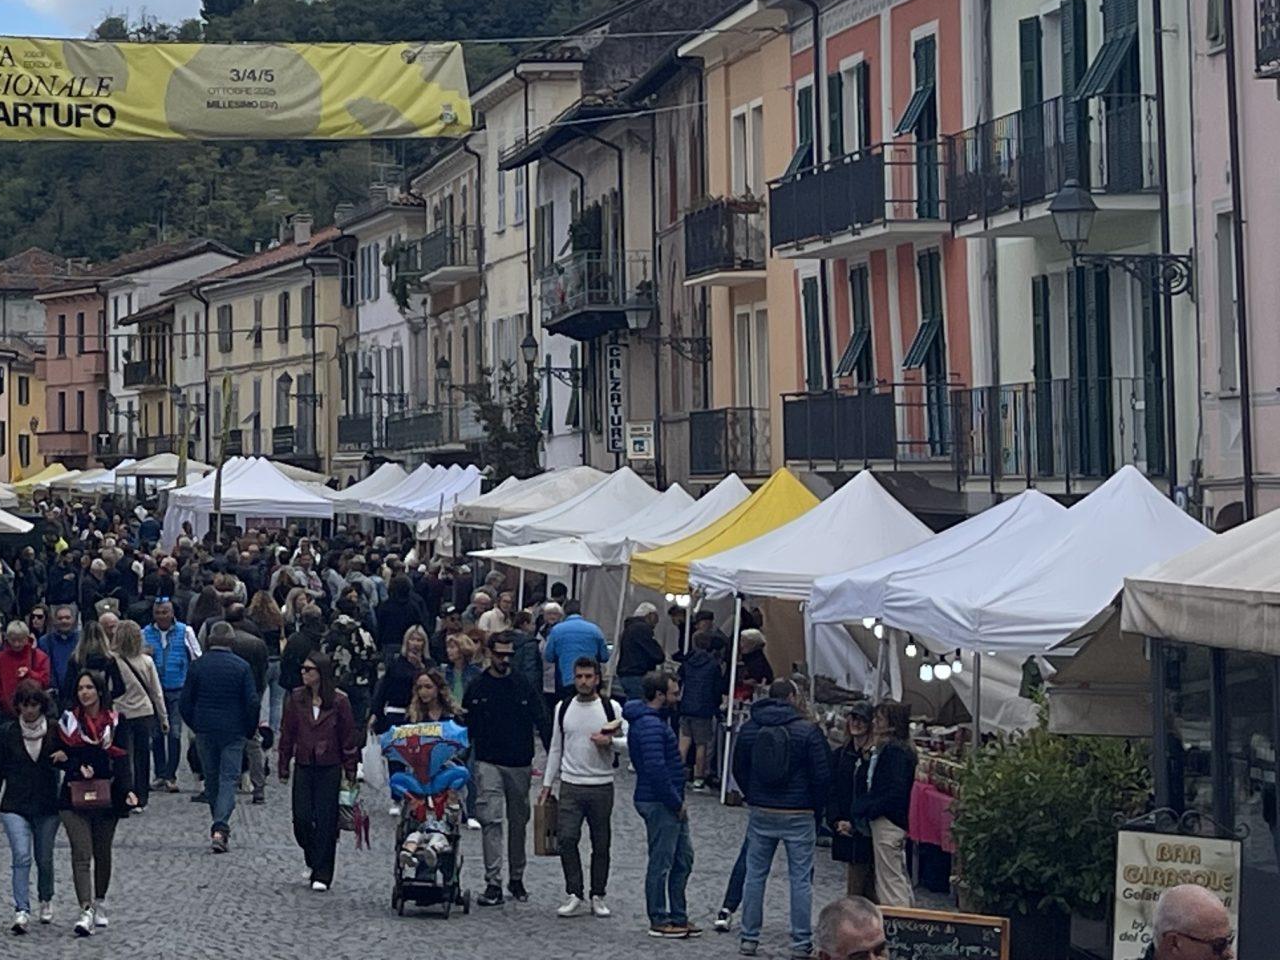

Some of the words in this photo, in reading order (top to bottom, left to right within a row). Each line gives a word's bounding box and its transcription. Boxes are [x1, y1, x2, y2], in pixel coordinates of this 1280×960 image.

[229, 68, 274, 83] 3/4/5
[608, 346, 623, 451] CALZATURE
[1156, 842, 1201, 865] BAR
[1123, 864, 1234, 893] GIRASOLE
